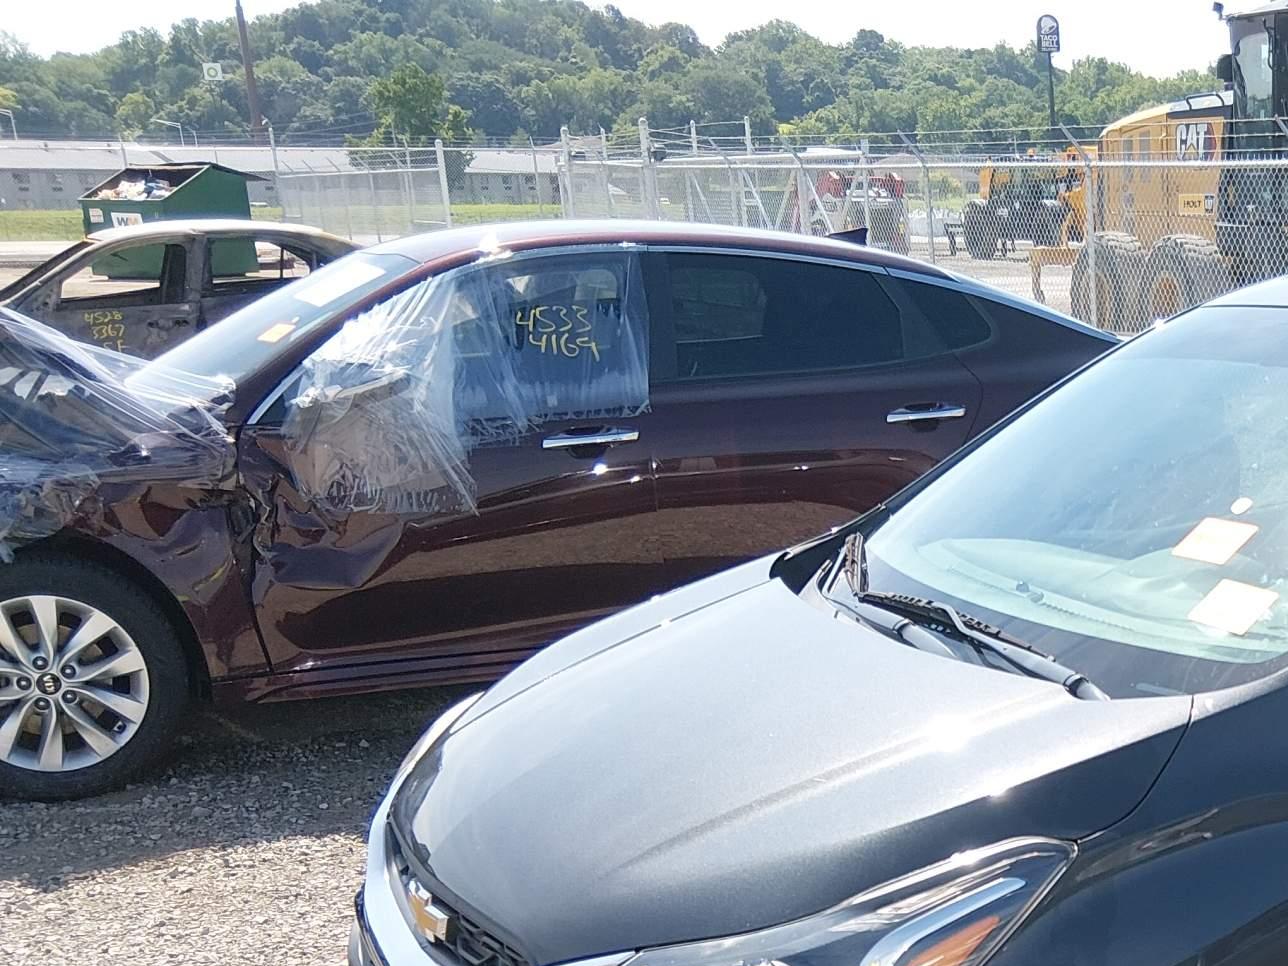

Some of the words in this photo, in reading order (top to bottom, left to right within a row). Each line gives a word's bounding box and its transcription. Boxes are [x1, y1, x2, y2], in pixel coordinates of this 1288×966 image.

[1042, 40, 1059, 48] BELL
[1176, 123, 1208, 161] CAT
[1183, 200, 1202, 209] HOLT
[84, 311, 124, 326] 4528
[516, 305, 592, 333] 4533
[529, 333, 600, 362] 4169
